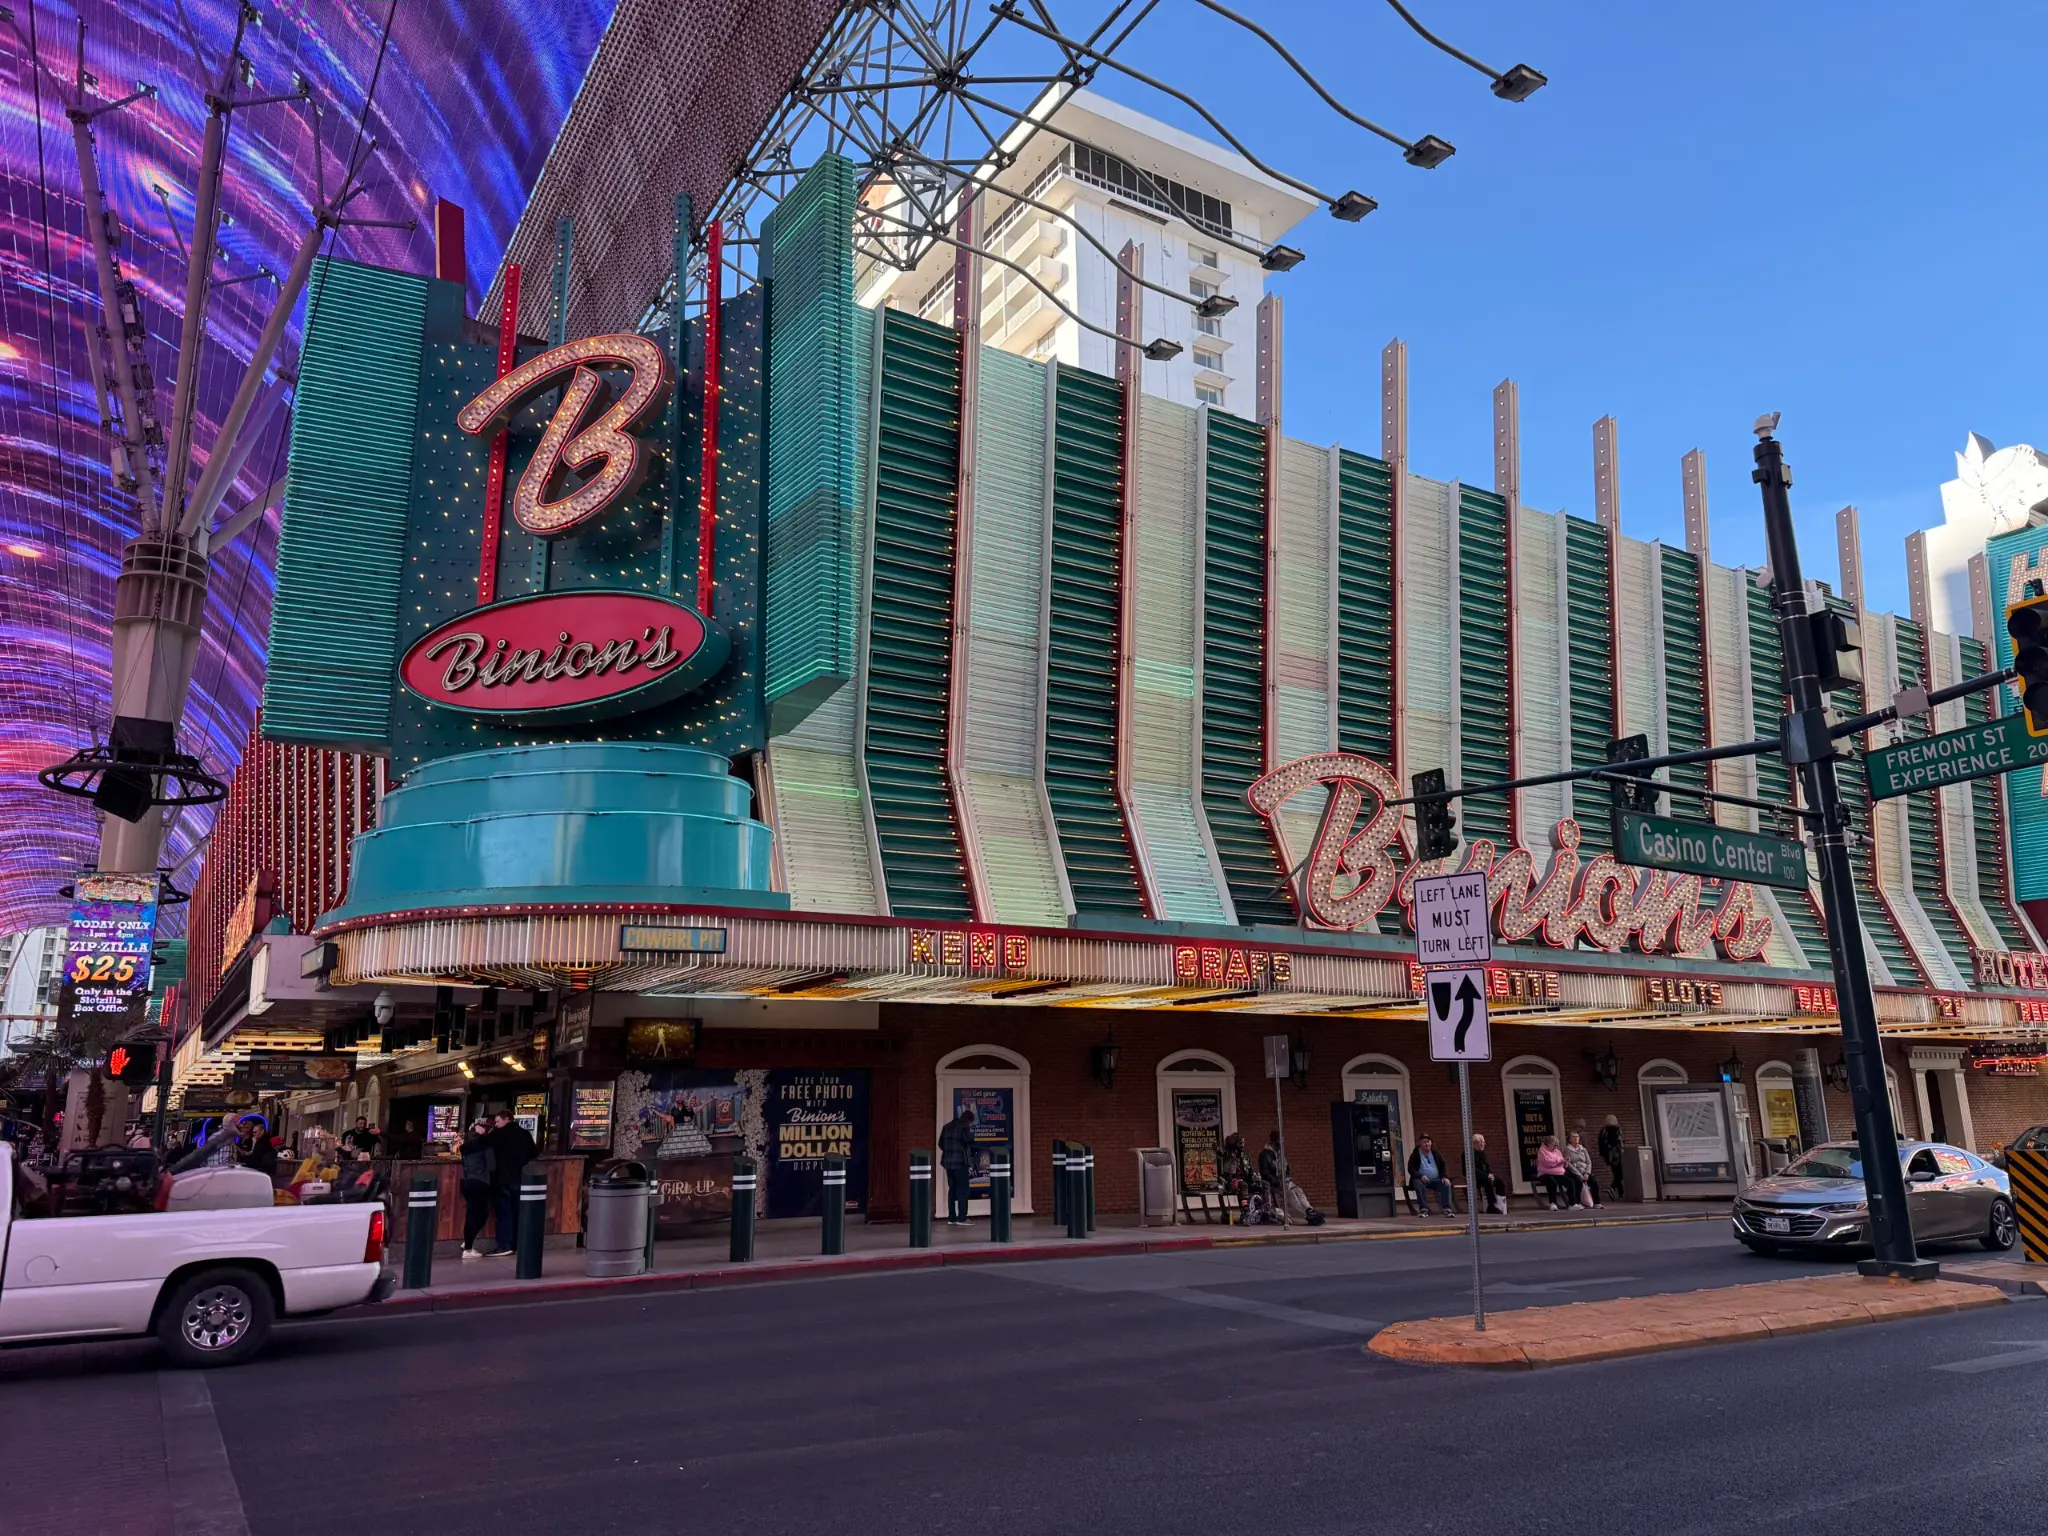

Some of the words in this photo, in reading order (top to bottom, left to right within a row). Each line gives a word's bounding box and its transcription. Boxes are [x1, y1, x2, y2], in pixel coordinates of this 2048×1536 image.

[457, 334, 664, 535] B
[425, 624, 679, 692] Binion's
[1885, 733, 1977, 770] FREMONT
[1982, 726, 2006, 746] ST
[1889, 747, 2014, 790] EXPERIENCE
[1623, 815, 1630, 831] S
[1639, 822, 1707, 864] Casino
[1712, 835, 1774, 875] Center
[1781, 844, 1801, 860] Blvd
[1783, 866, 1796, 881] 100
[1420, 887, 1445, 903] LEFT
[1451, 884, 1481, 901] LANE
[74, 920, 115, 929] TODAY
[117, 921, 151, 930] ONLY
[1432, 910, 1471, 928] MUST
[89, 929, 107, 937] 1pm
[626, 928, 693, 949] COWGIRL
[701, 930, 724, 949] PIT
[69, 941, 149, 952] ZIP-ZILLA
[909, 930, 1029, 970] KENO
[1422, 938, 1450, 953] TURN
[1458, 936, 1485, 951] LEFT
[71, 955, 137, 983] $25
[1176, 945, 1291, 983] CRAPS
[1976, 948, 2048, 990] HOTE
[75, 987, 101, 997] Only
[103, 988, 114, 996] in
[116, 987, 132, 996] the
[1649, 977, 1723, 1005] SLOTS
[74, 1004, 94, 1012] Box
[96, 1004, 128, 1012] Office
[80, 996, 122, 1004] Slotzilla
[781, 1085, 810, 1100] FREE
[815, 1085, 853, 1100] PHOTO
[786, 1107, 847, 1123] Binion's
[779, 1124, 853, 1141] MILLION
[1522, 1124, 1546, 1133] WATCH
[1523, 1135, 1535, 1145] ALL
[780, 1141, 852, 1158] DOLLAR
